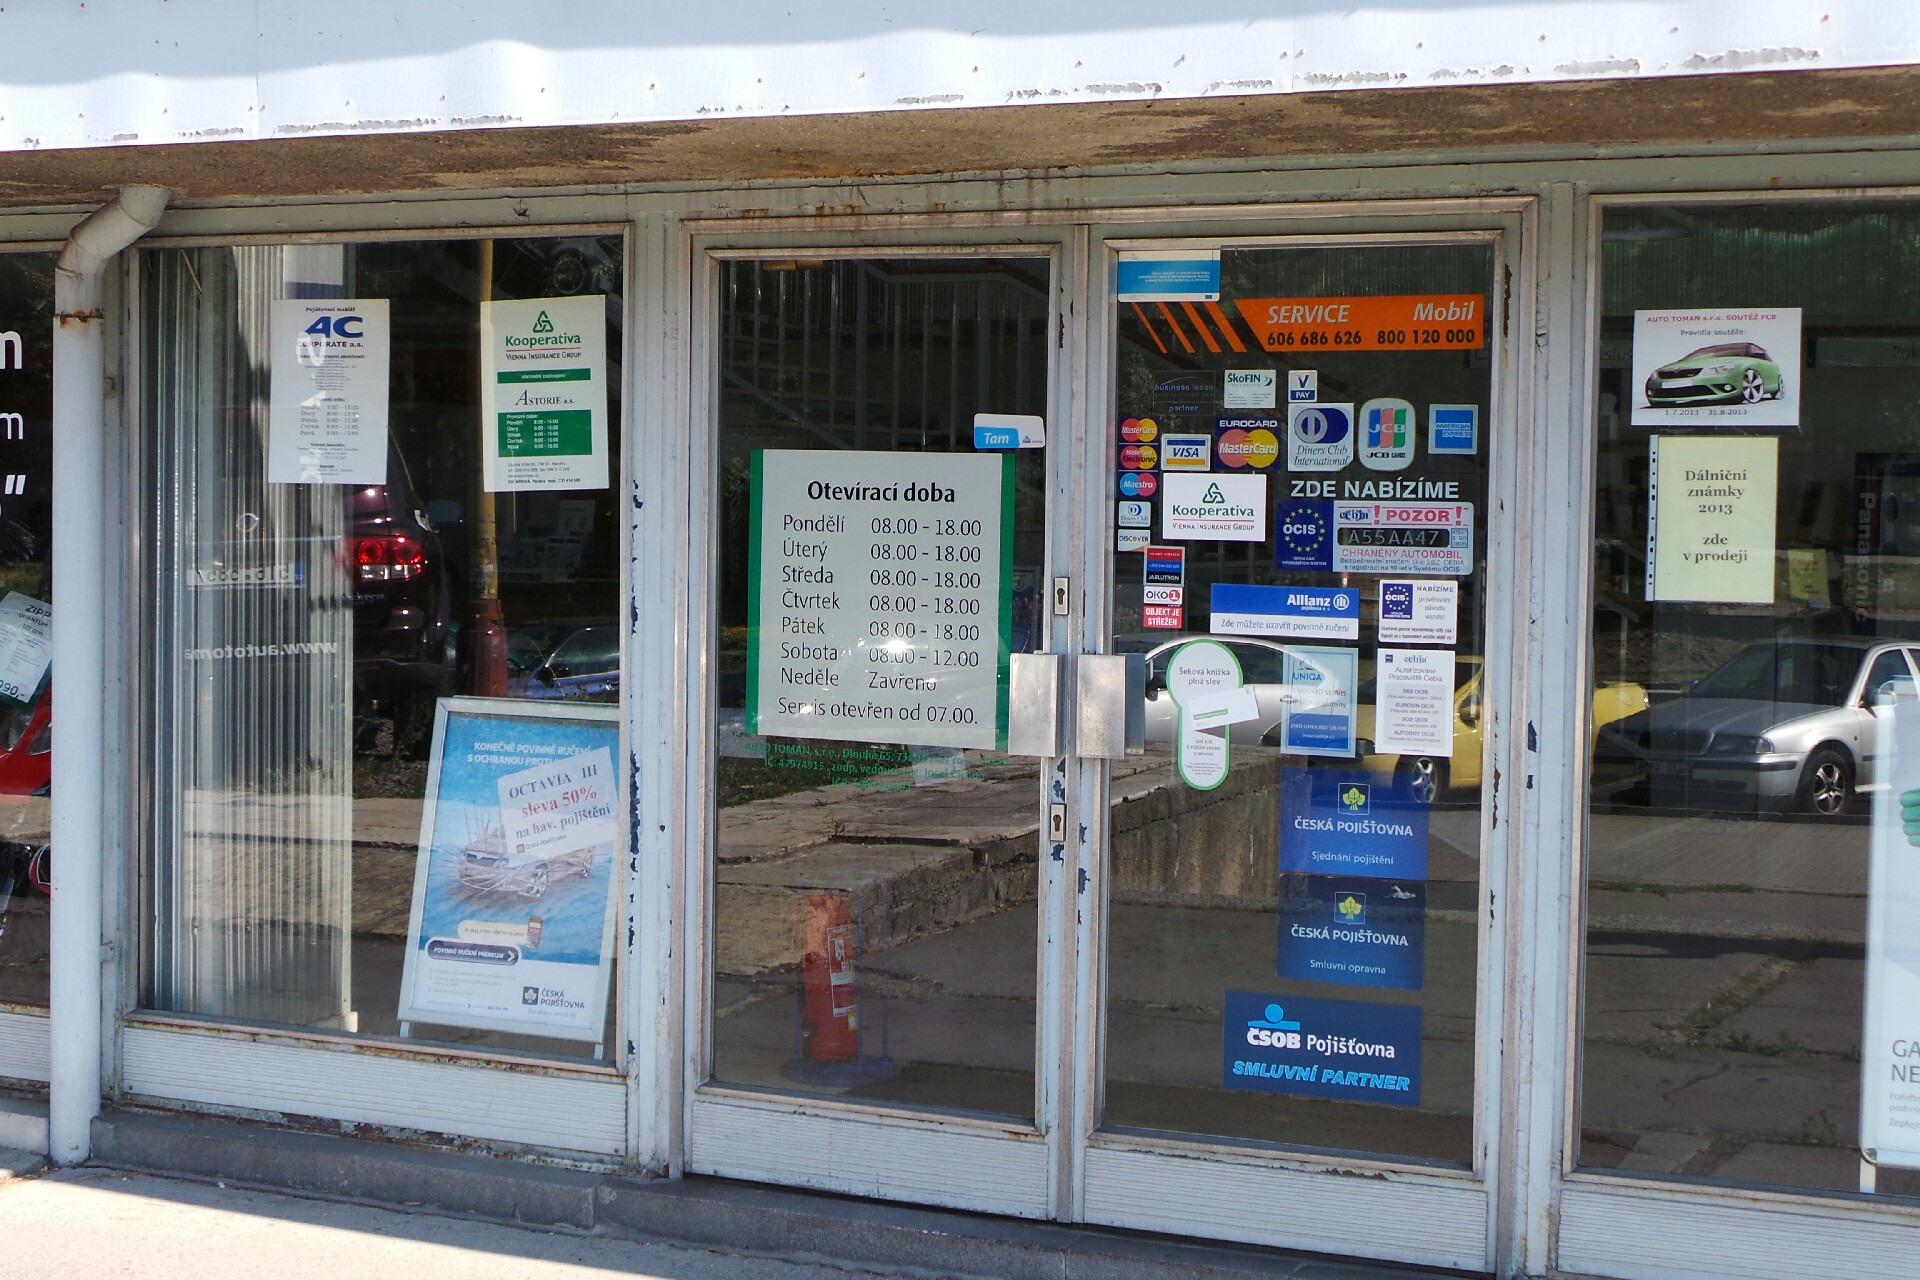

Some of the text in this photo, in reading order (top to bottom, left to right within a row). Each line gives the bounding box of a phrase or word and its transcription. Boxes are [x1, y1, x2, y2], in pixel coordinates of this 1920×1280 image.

[1267, 301, 1475, 324] SERVICE Mobil
[1726, 312, 1758, 321] SOUTĚŽ
[305, 316, 363, 338] AC
[506, 333, 581, 348] Kooperativa
[1267, 329, 1475, 345] 606 686 626 800 120 000
[1227, 373, 1261, 383] ŠkoFIN
[1295, 391, 1310, 399] PAY
[1121, 426, 1157, 434] MasterCard
[1219, 420, 1278, 428] EUROCARD
[1369, 423, 1406, 433] JCB
[984, 432, 1009, 444] Tam
[1442, 430, 1472, 438] EXPRESS
[1171, 447, 1199, 458] VISA
[1219, 442, 1278, 455] MasterCard
[1297, 445, 1348, 456] Diners Club
[1293, 455, 1350, 466] International
[1684, 468, 1747, 483] Dálniční
[807, 480, 956, 503] Otevírací doba
[1123, 481, 1153, 489] Maestro
[1290, 476, 1459, 499] ZDE NABÍZÍME
[1687, 484, 1745, 500] známky
[1172, 504, 1255, 518] Kooperativa
[1386, 510, 1450, 522] POZOR
[1698, 503, 1733, 516] 2013
[783, 514, 982, 537] Pondělí 08.00 18.00
[1172, 522, 1255, 531] VIENNA INSURANCE GROUP
[1282, 523, 1316, 535] OCIS
[1348, 529, 1440, 545] A55AA47
[1702, 533, 1729, 546] zde
[783, 537, 981, 563] Úterý 08.00 18.00
[1341, 547, 1463, 559] CHRÁNĚNÝ AUTOMOBIL
[1683, 550, 1748, 564] v prodeji
[1855, 492, 1876, 623] Panasonic
[782, 565, 981, 589] Středa 08.00 18.00
[1416, 585, 1454, 593] NABÍZÍME
[781, 587, 980, 615] Čtvrtek 08.00 18.00
[1287, 594, 1331, 607] Allianz
[25, 604, 52, 618] ZIPP
[1145, 607, 1180, 617] OBJEKT JE
[18, 612, 49, 629] QUANTUM
[1147, 616, 1178, 626] STŘEŽEN
[1221, 618, 1349, 633] Zde můžete uzavřít povinné ručení
[781, 616, 979, 641] Pátek 08.00 18.00
[781, 641, 979, 668] Sobota 08.00 12.00
[1404, 654, 1427, 663] cebia
[1179, 667, 1230, 676] Šeková knížka
[1395, 666, 1437, 674] Autorizované
[781, 667, 937, 691] Neděle Zavřeno
[1188, 677, 1221, 686] plná slev
[1293, 673, 1322, 681] UNIQA
[1388, 673, 1443, 682] Pracoviště Cebia
[778, 697, 978, 725] Servis otevřen od 07.00.
[474, 742, 516, 753] KONEČNÉ
[516, 743, 556, 755] POVINNÉ
[467, 754, 473, 763] S
[474, 754, 524, 765] OCHRANOU
[778, 758, 824, 771] 47974915
[509, 764, 598, 799] OCTAVIA III
[521, 785, 597, 819] sleva 50%
[516, 828, 530, 839] na
[533, 822, 557, 835] hav.
[1294, 815, 1414, 837] ČESKÁ POJIŠŤOVNA
[1311, 850, 1394, 866] Sjednání pojištění
[1291, 923, 1408, 947] ČESKÁ POJIŠŤOVNA
[433, 946, 505, 959] POVINNÉ RUČENÍ PREMIUM
[1310, 959, 1386, 975] Smluvní opravna
[541, 987, 565, 999] ČESKÁ
[540, 996, 585, 1009] POJIŠŤOVNA
[1246, 1027, 1395, 1059] ČSOB Pojišťovna
[1232, 1060, 1411, 1092] SMLUVNÍ PARTNER
